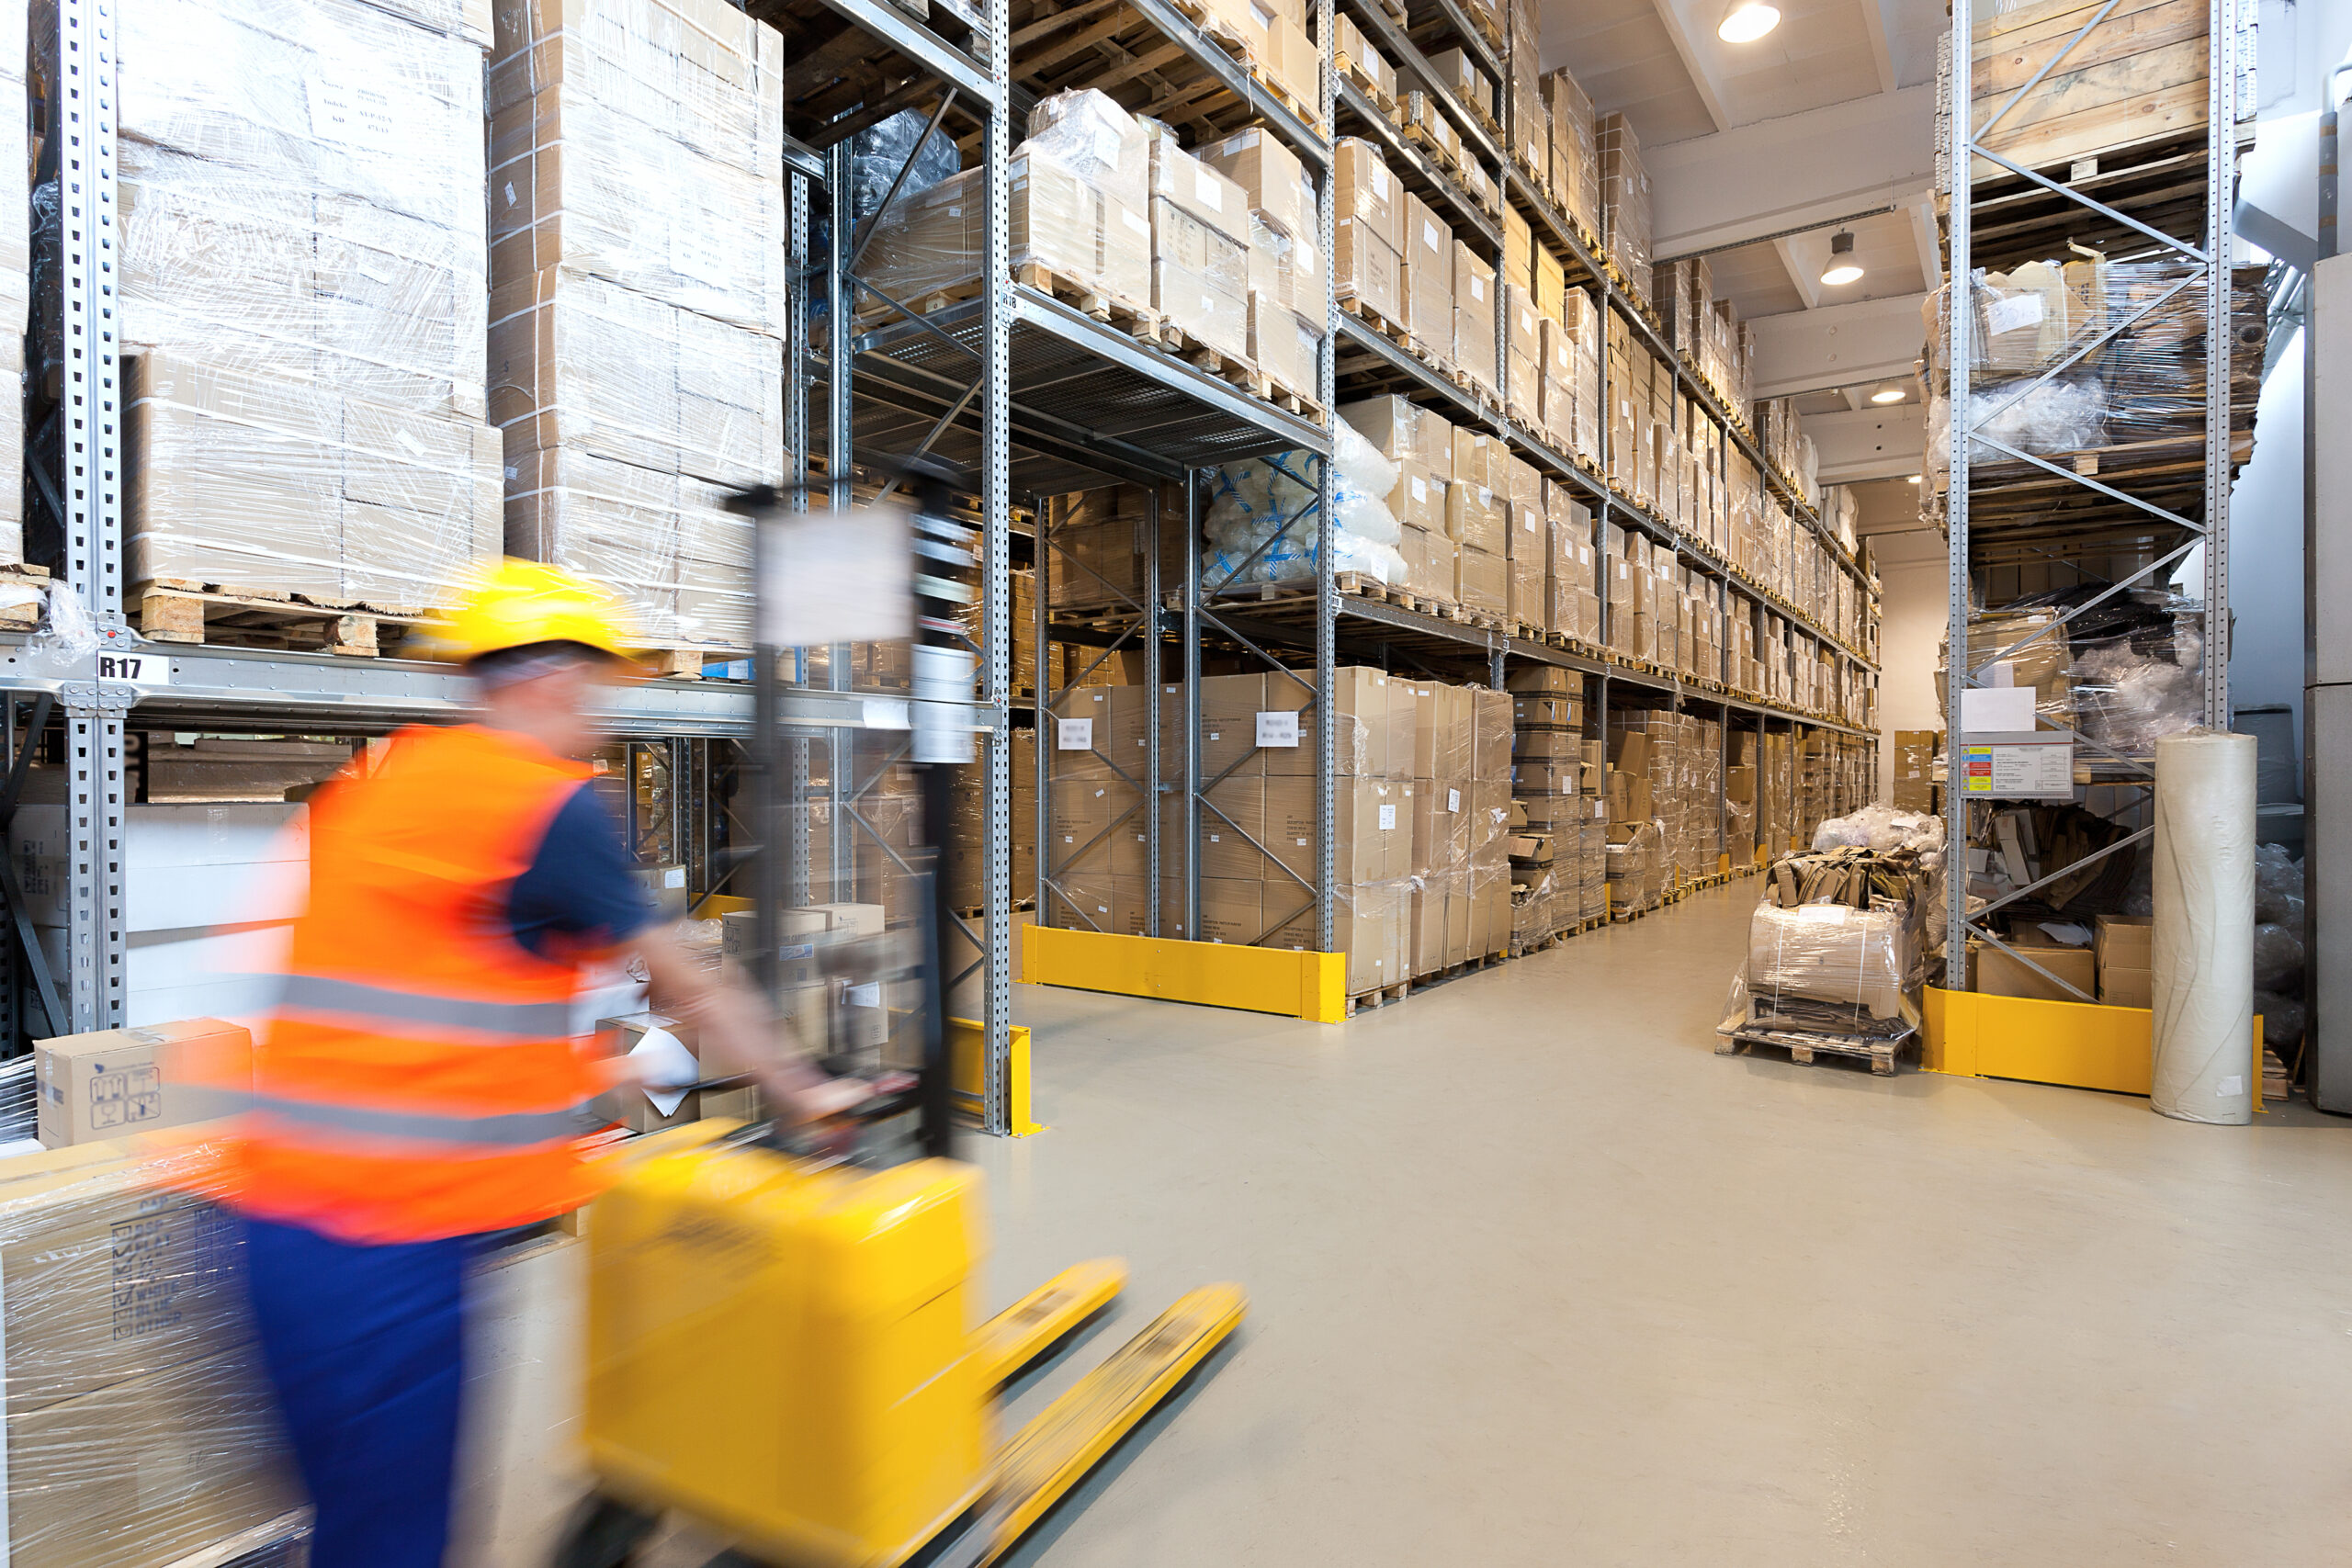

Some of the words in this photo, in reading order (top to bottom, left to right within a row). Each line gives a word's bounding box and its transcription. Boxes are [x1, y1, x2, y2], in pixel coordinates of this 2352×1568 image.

[1002, 292, 1017, 309] R18
[99, 656, 141, 680] R17
[135, 1278, 182, 1302] WHITE
[135, 1311, 183, 1335] OTHER
